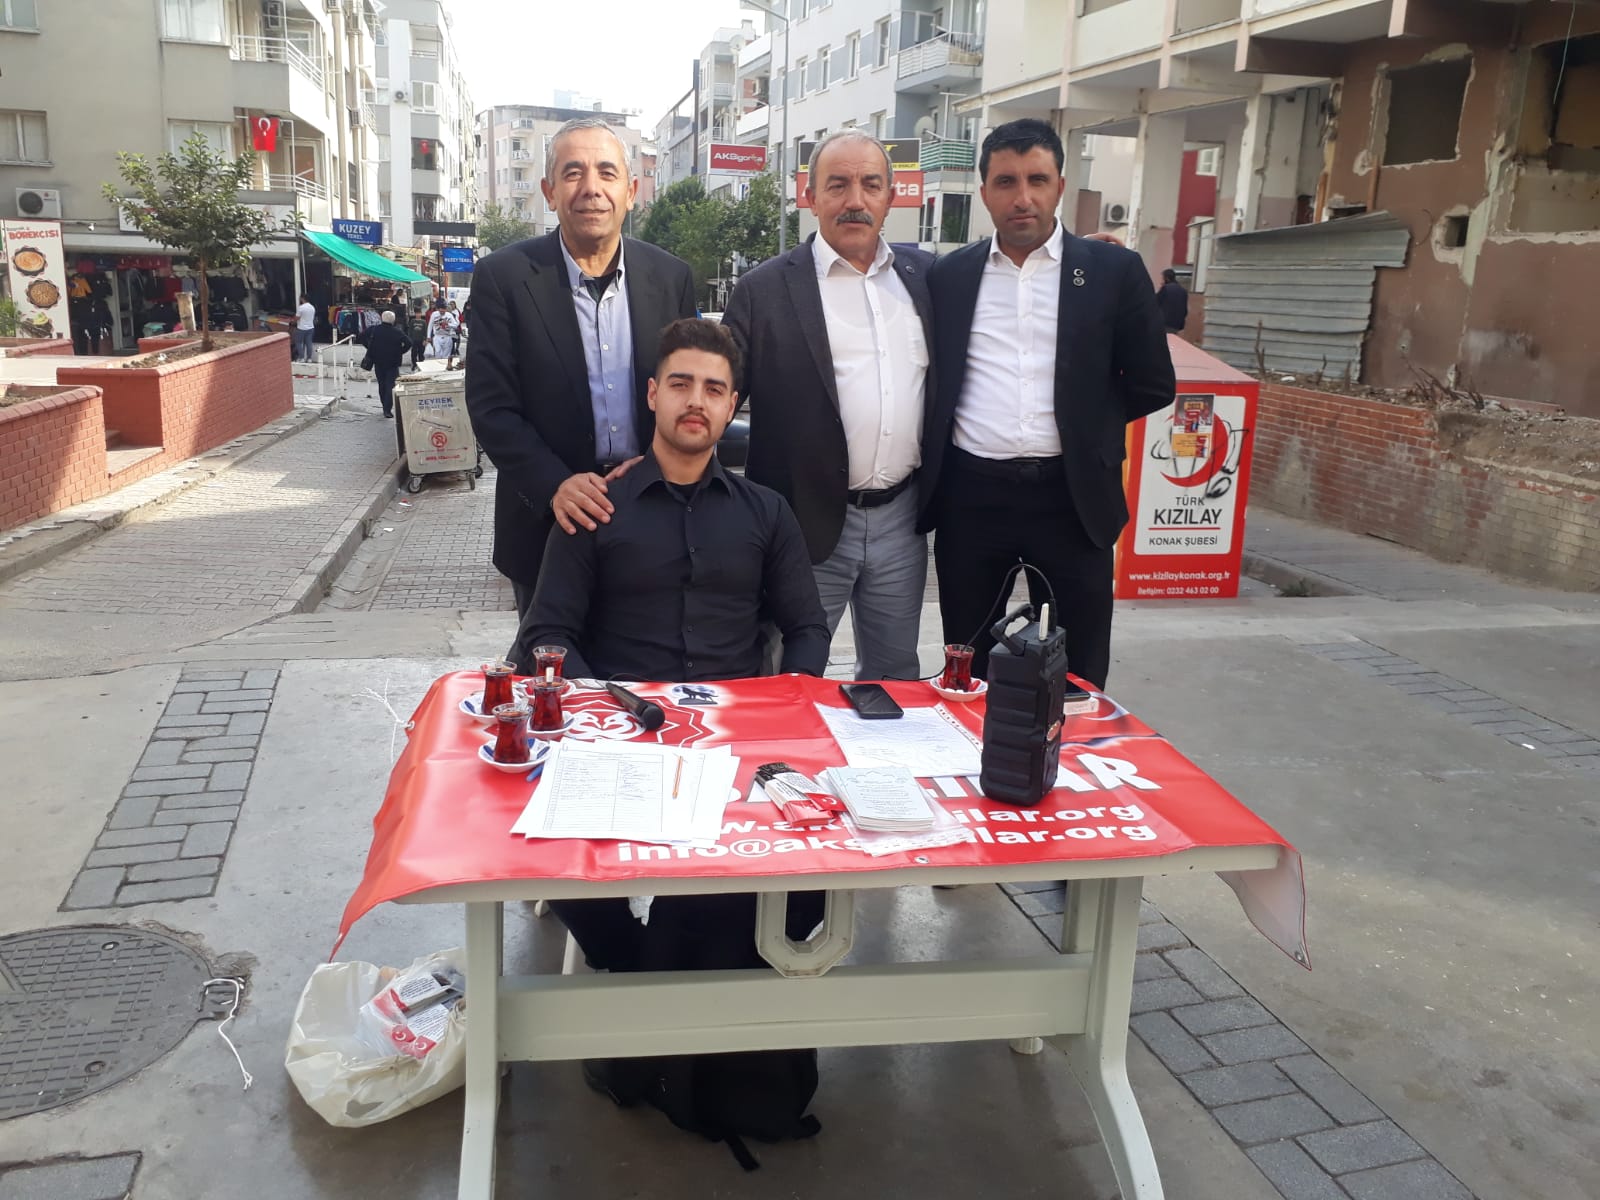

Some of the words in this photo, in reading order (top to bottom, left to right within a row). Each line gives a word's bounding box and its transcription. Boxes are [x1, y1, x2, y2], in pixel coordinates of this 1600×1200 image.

[339, 224, 371, 234] KUZEY
[1175, 495, 1205, 506] TÜRK
[1153, 508, 1222, 525] KIZILAY
[1149, 537, 1182, 546] KONAK
[1184, 535, 1218, 546] ŞUBESİ
[1166, 587, 1184, 595] 0232
[1210, 586, 1219, 594] 00
